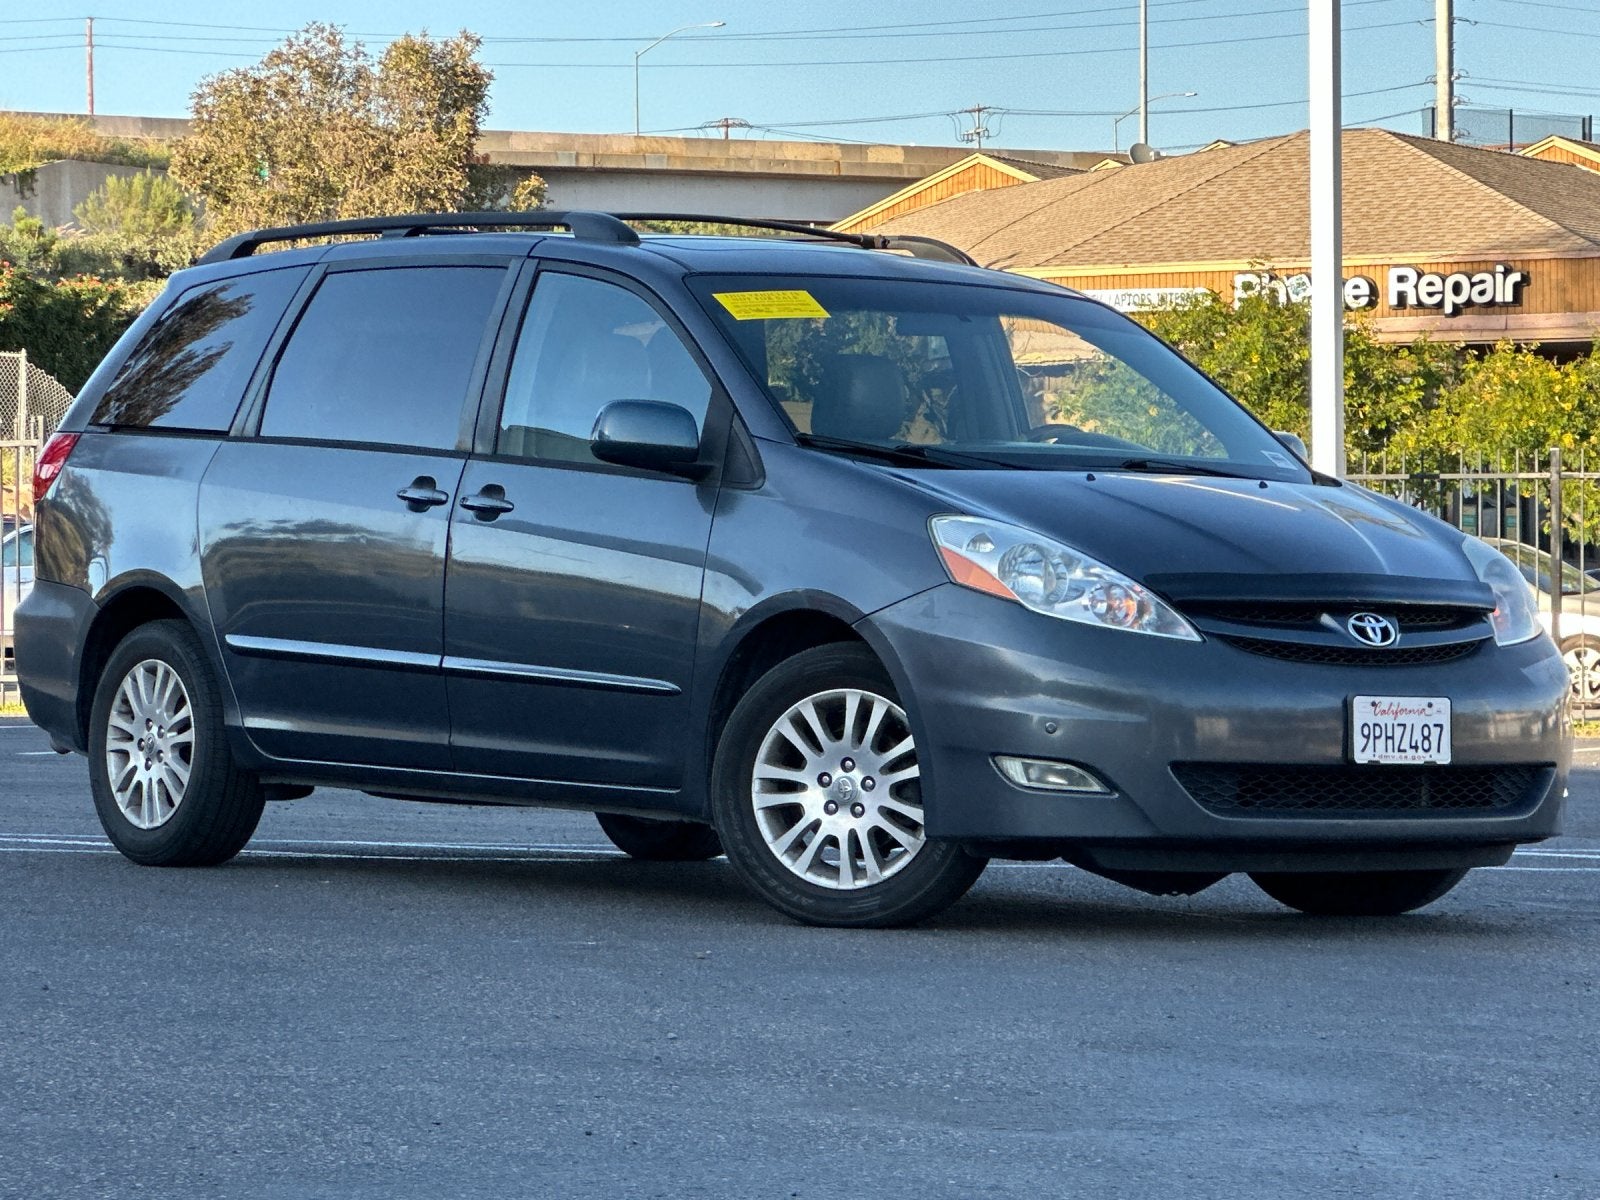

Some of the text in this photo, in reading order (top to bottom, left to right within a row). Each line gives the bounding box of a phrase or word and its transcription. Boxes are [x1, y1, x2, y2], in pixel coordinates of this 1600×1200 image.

[1233, 264, 1521, 313] Phoe Repair
[1373, 701, 1429, 721] California
[1360, 722, 1444, 754] 9PHZ487
